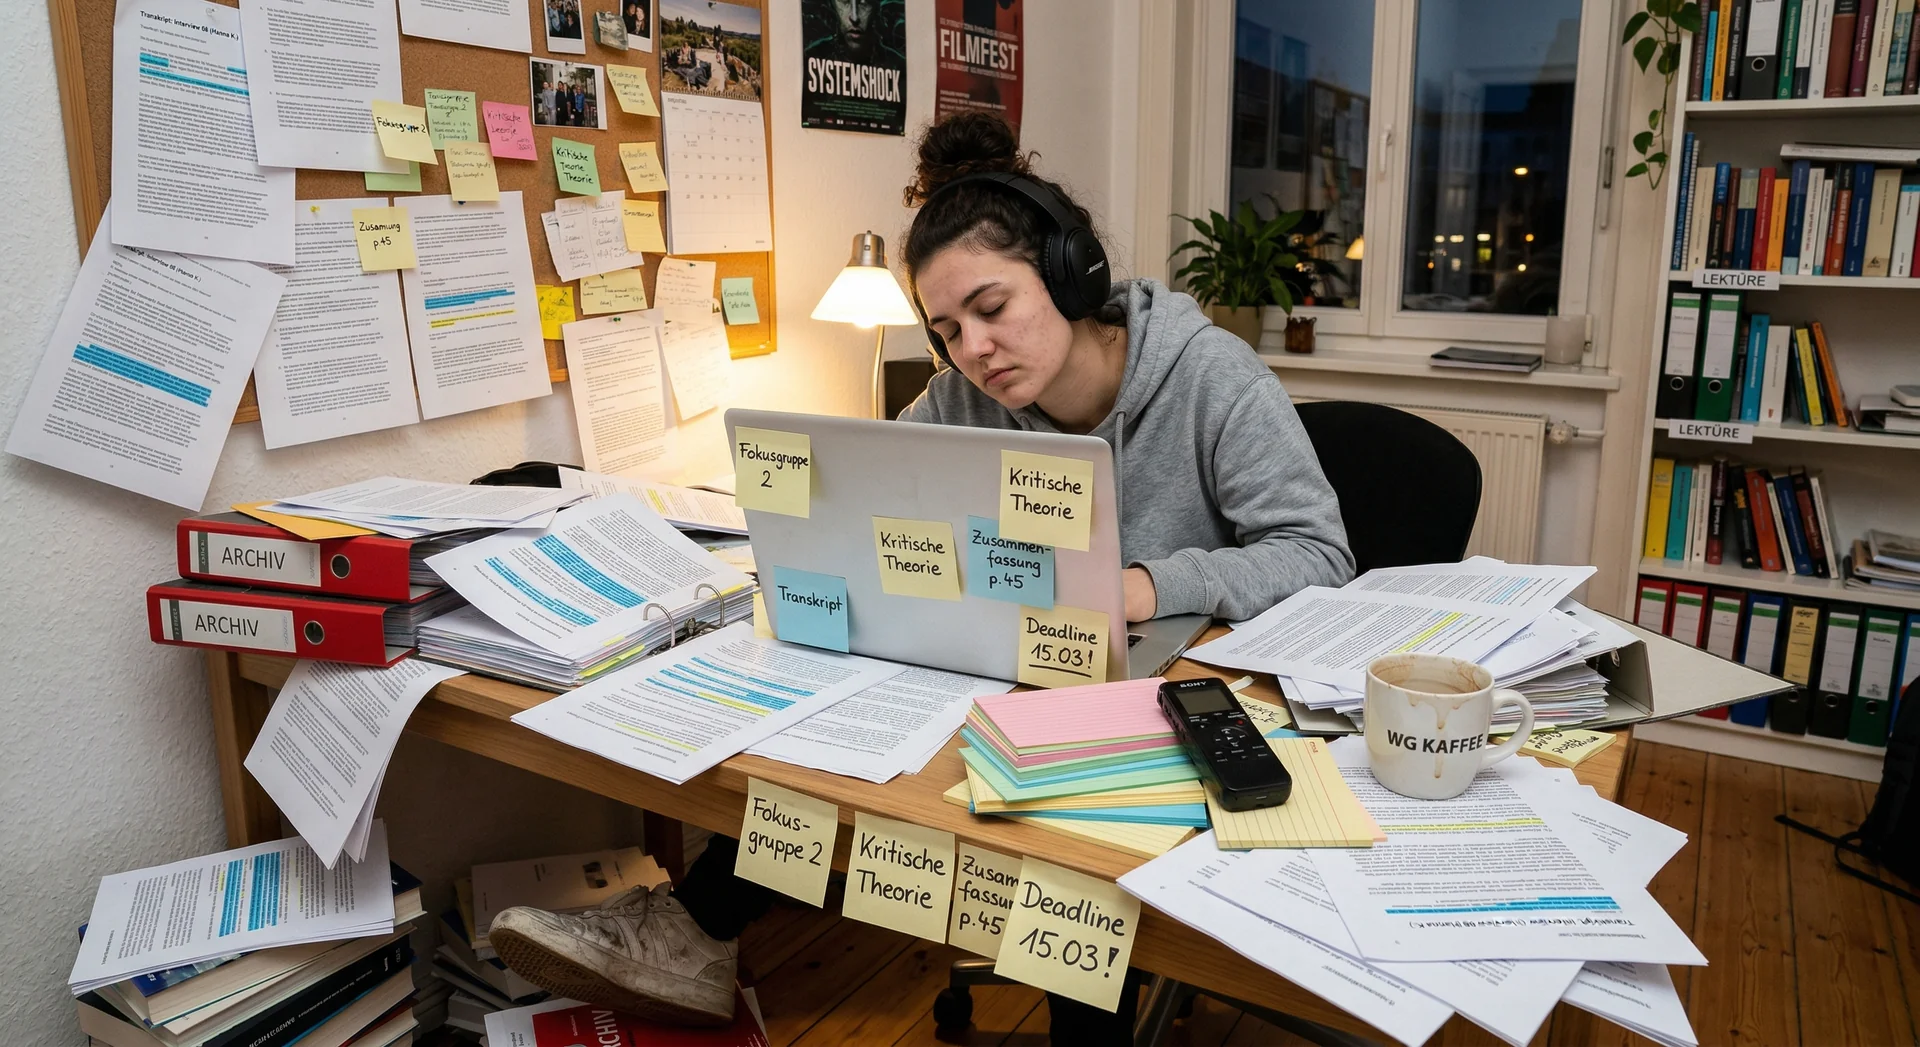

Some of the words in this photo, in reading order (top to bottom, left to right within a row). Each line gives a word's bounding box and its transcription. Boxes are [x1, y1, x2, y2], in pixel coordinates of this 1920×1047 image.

[174, 18, 201, 31] Interview
[210, 27, 230, 38] (Hanna
[940, 28, 1018, 72] FILMFEST
[808, 56, 901, 103] SYSTEMSHOCK
[421, 123, 426, 133] 2
[1702, 271, 1766, 287] LEKTÜRE
[1679, 424, 1740, 439] LEKTÜRE
[739, 442, 809, 470] Fokusgruppe
[760, 470, 773, 489] 2
[1009, 467, 1083, 495] Kritische
[1010, 494, 1075, 520] Theorie
[880, 531, 946, 555] Kritische
[972, 529, 1052, 555] Zusammen-
[221, 546, 286, 570] ARCHIV
[883, 555, 942, 576] Theorie
[986, 549, 1041, 578] fassung
[989, 572, 1024, 589] p.45
[778, 585, 843, 615] Transkript
[195, 614, 259, 637] ARCHIV
[1026, 617, 1098, 645] Deadline
[1031, 644, 1094, 670] 15.03!
[1179, 680, 1207, 688] SONY
[1387, 729, 1417, 751] WG
[1422, 733, 1484, 754] KAFFEE
[753, 797, 811, 832] Fokus-
[748, 830, 804, 863] gruppe
[808, 841, 824, 866] 2
[859, 832, 946, 876] Kritische
[856, 869, 933, 910] Theorie
[1019, 880, 1126, 938] Deadline
[959, 911, 1005, 935] p.45
